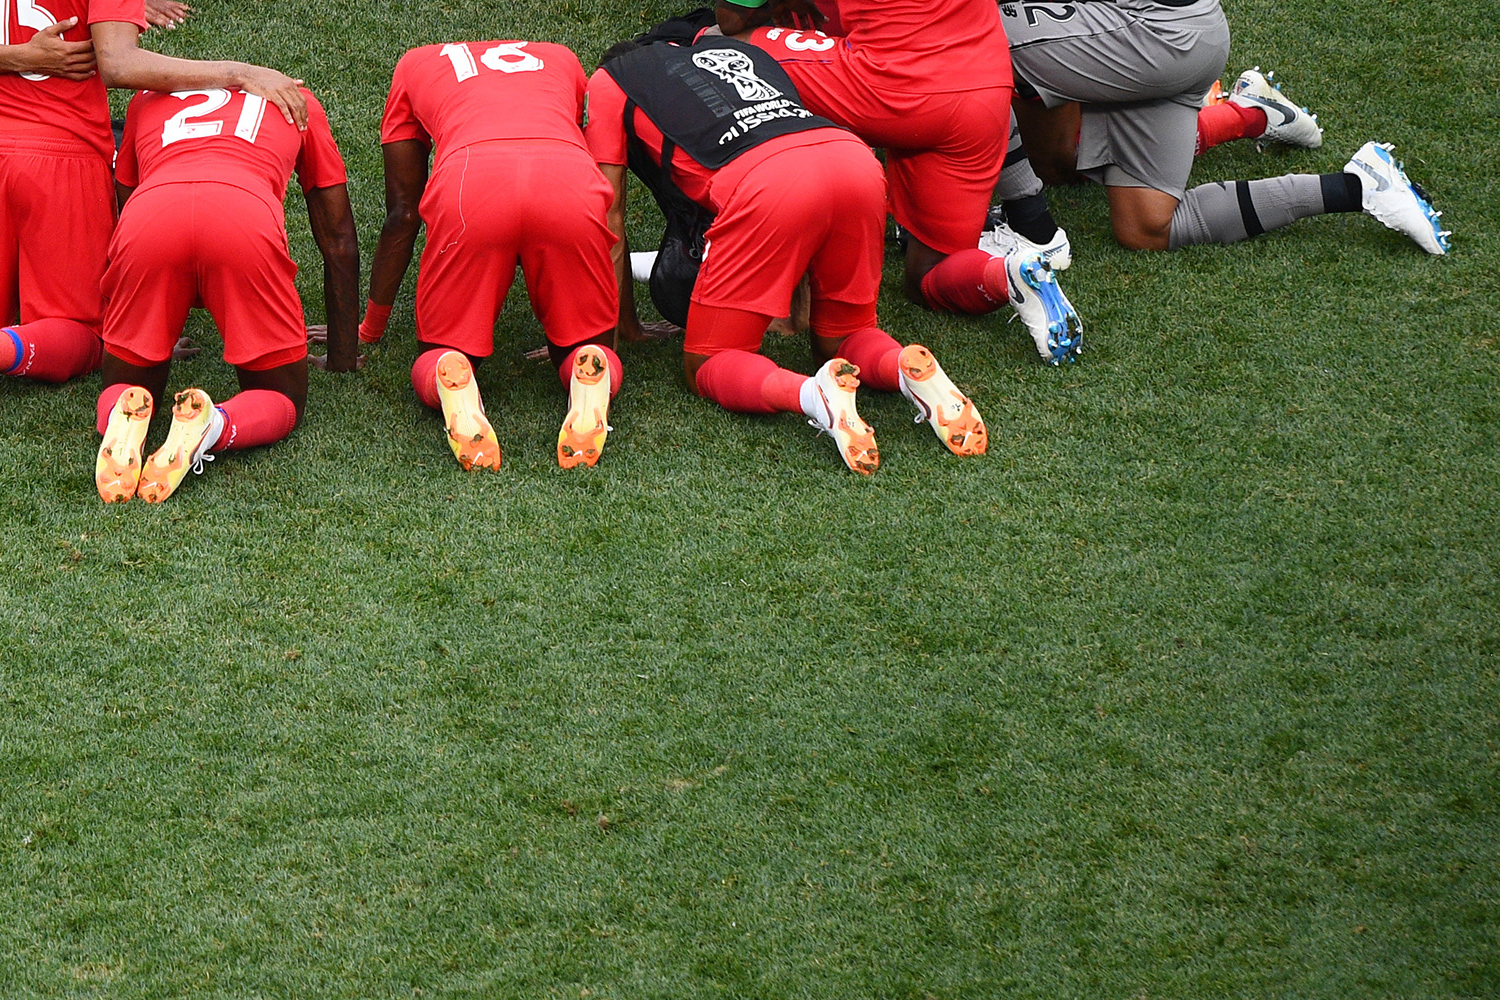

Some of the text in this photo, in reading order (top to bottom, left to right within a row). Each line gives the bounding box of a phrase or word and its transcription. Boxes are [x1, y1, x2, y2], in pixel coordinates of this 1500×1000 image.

[440, 41, 544, 83] 16
[161, 88, 267, 148] 21
[733, 106, 756, 120] FIFA
[754, 99, 790, 114] WORLD
